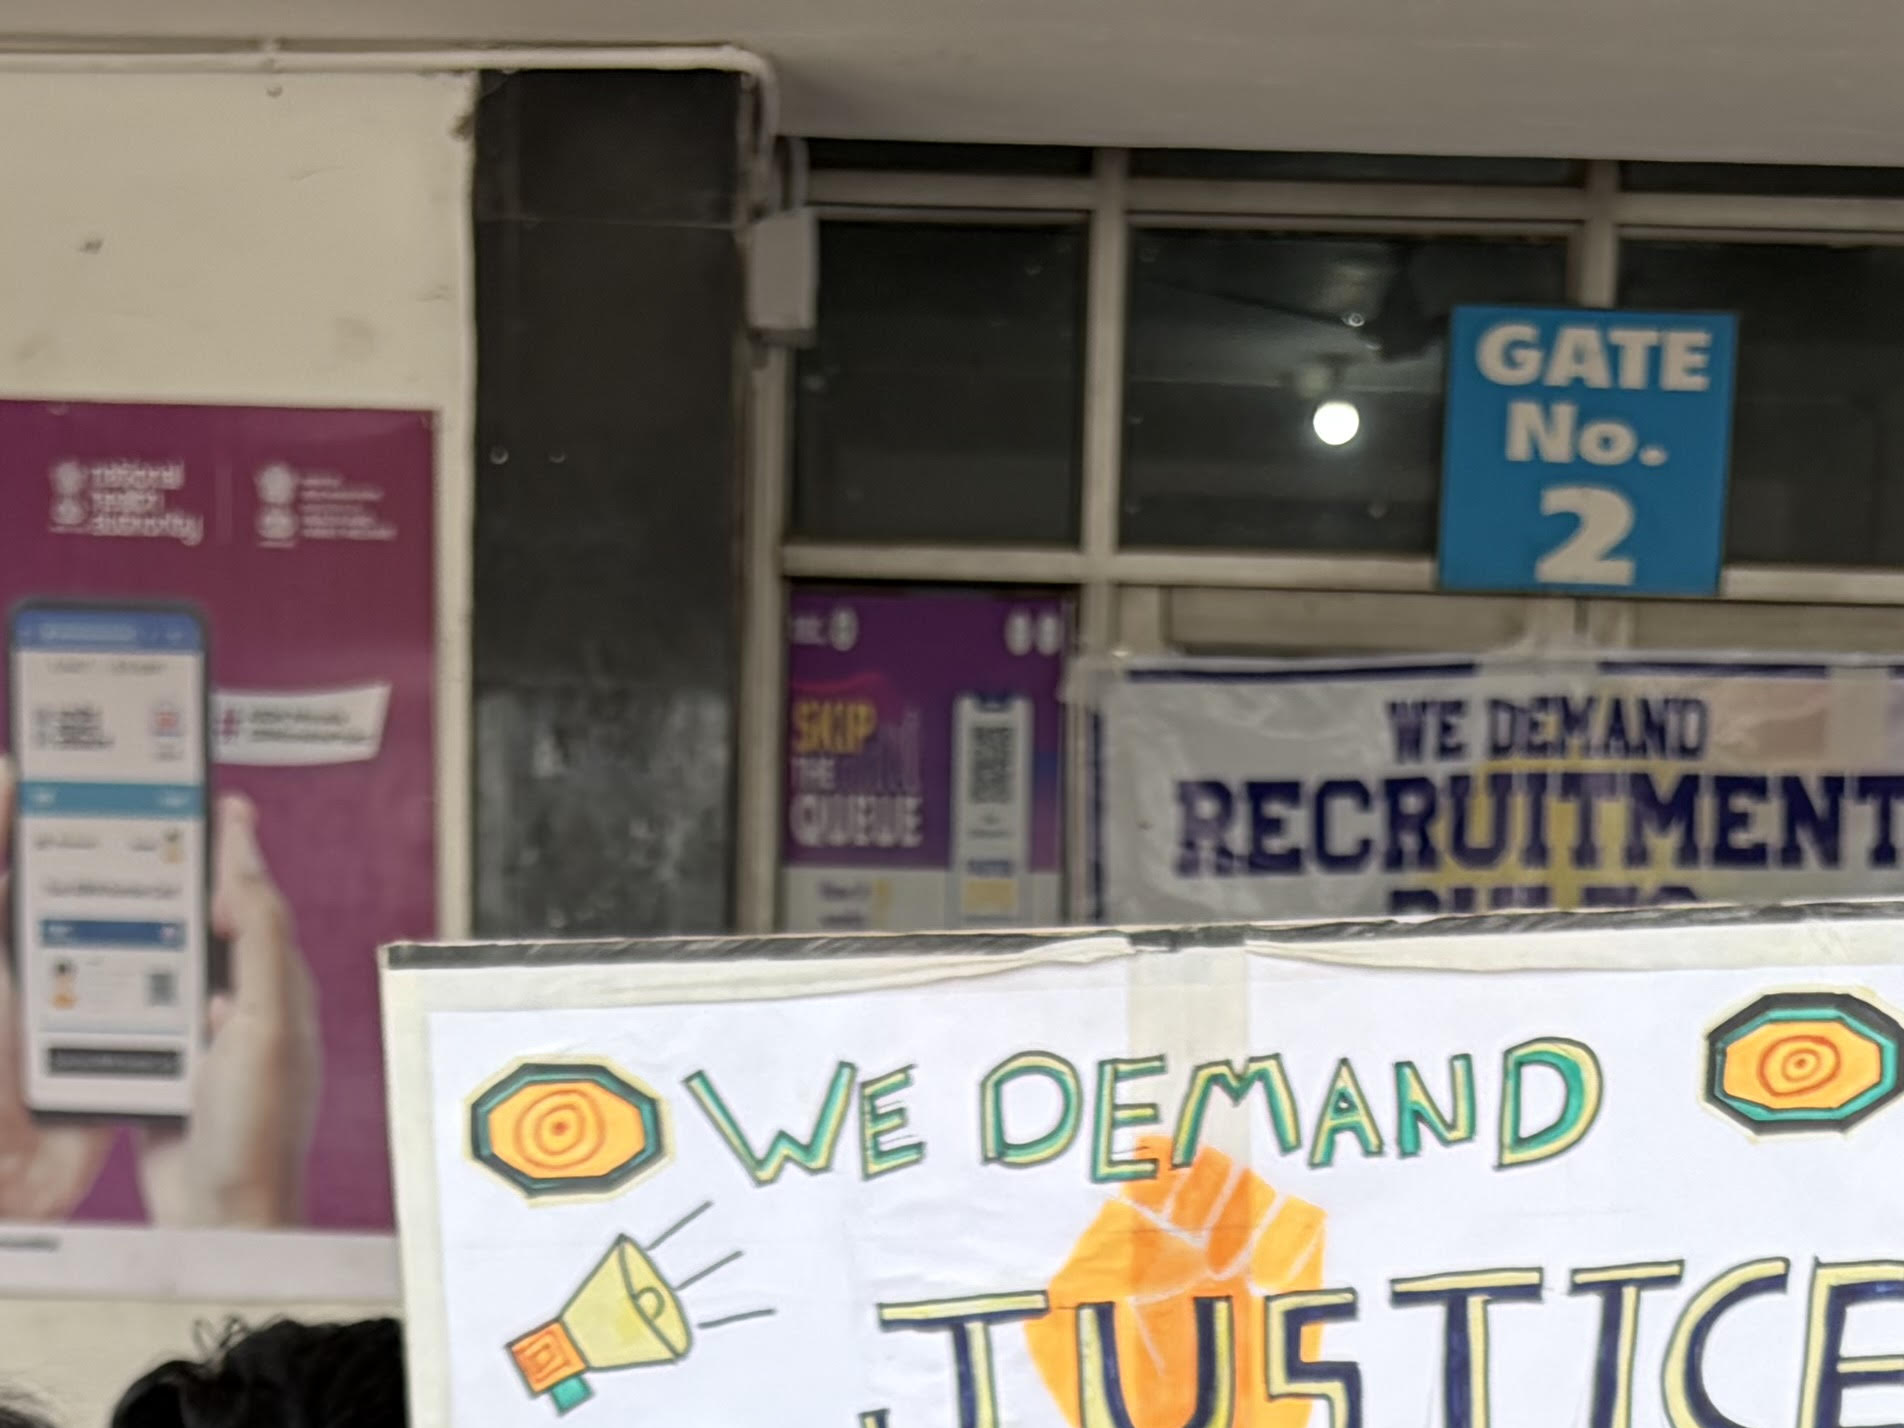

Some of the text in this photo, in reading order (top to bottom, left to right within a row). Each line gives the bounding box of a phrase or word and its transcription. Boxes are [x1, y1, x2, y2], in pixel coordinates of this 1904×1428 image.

[1475, 324, 1712, 392] GATE
[1505, 401, 1669, 467] No.
[1534, 484, 1636, 587] 2
[794, 699, 877, 755] SKIP
[1386, 694, 1710, 764] WE DEMAND
[790, 793, 924, 849] QUEUE
[681, 1035, 1604, 1188] WE DEMAND
